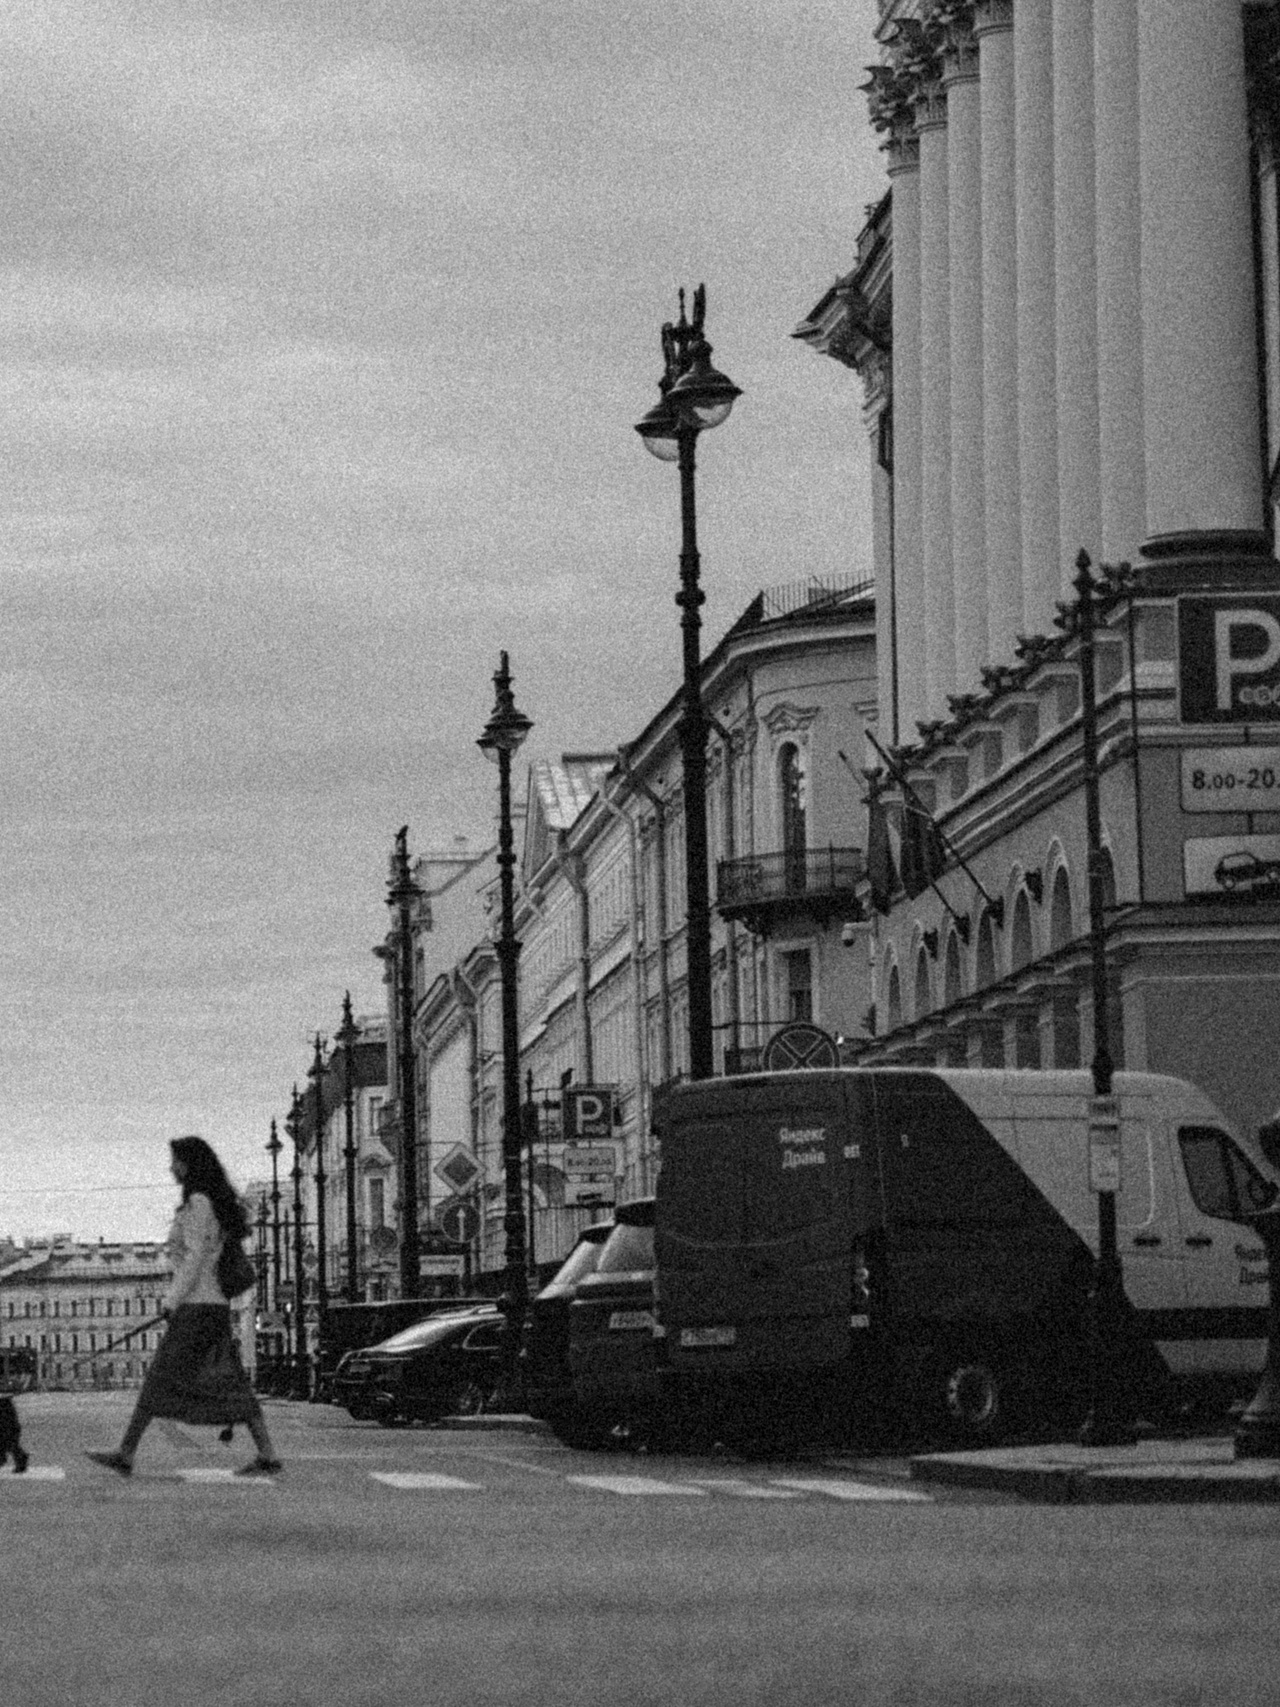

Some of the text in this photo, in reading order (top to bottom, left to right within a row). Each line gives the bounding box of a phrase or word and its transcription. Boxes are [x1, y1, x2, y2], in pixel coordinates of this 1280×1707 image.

[1215, 609, 1280, 710] P
[576, 1096, 604, 1135] P
[780, 1127, 826, 1144] Яндекс
[782, 1148, 826, 1169] Драйв
